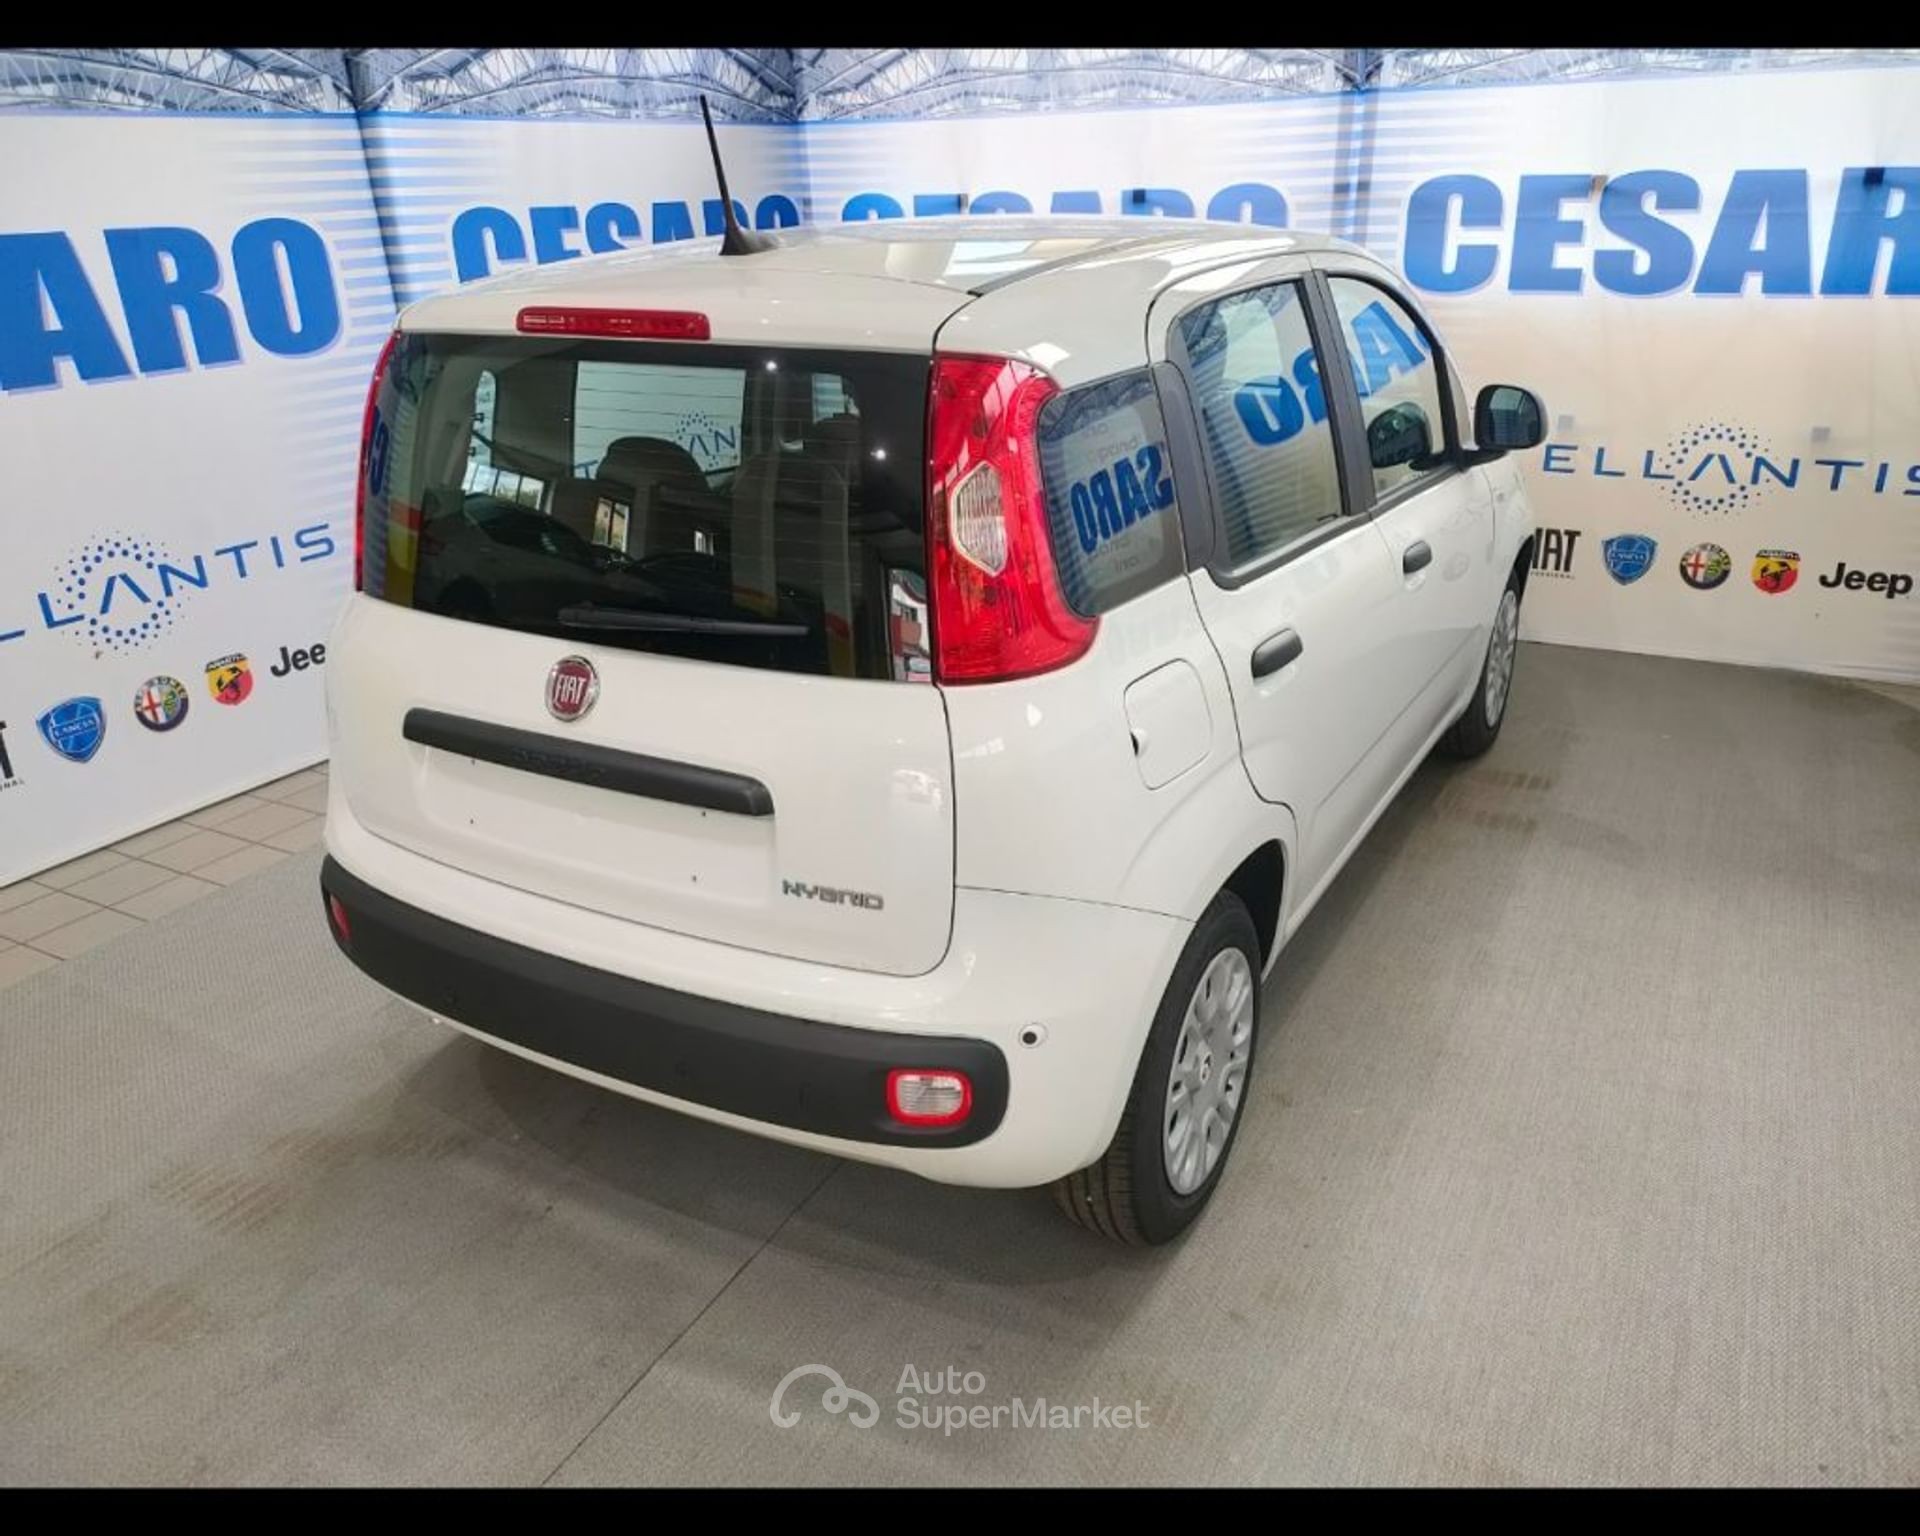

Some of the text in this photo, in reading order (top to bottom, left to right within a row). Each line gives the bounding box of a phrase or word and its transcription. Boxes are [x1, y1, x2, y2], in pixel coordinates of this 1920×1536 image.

[0, 523, 335, 642] LANTIS
[1819, 562, 1913, 599] Jeep
[553, 673, 587, 704] FIAT
